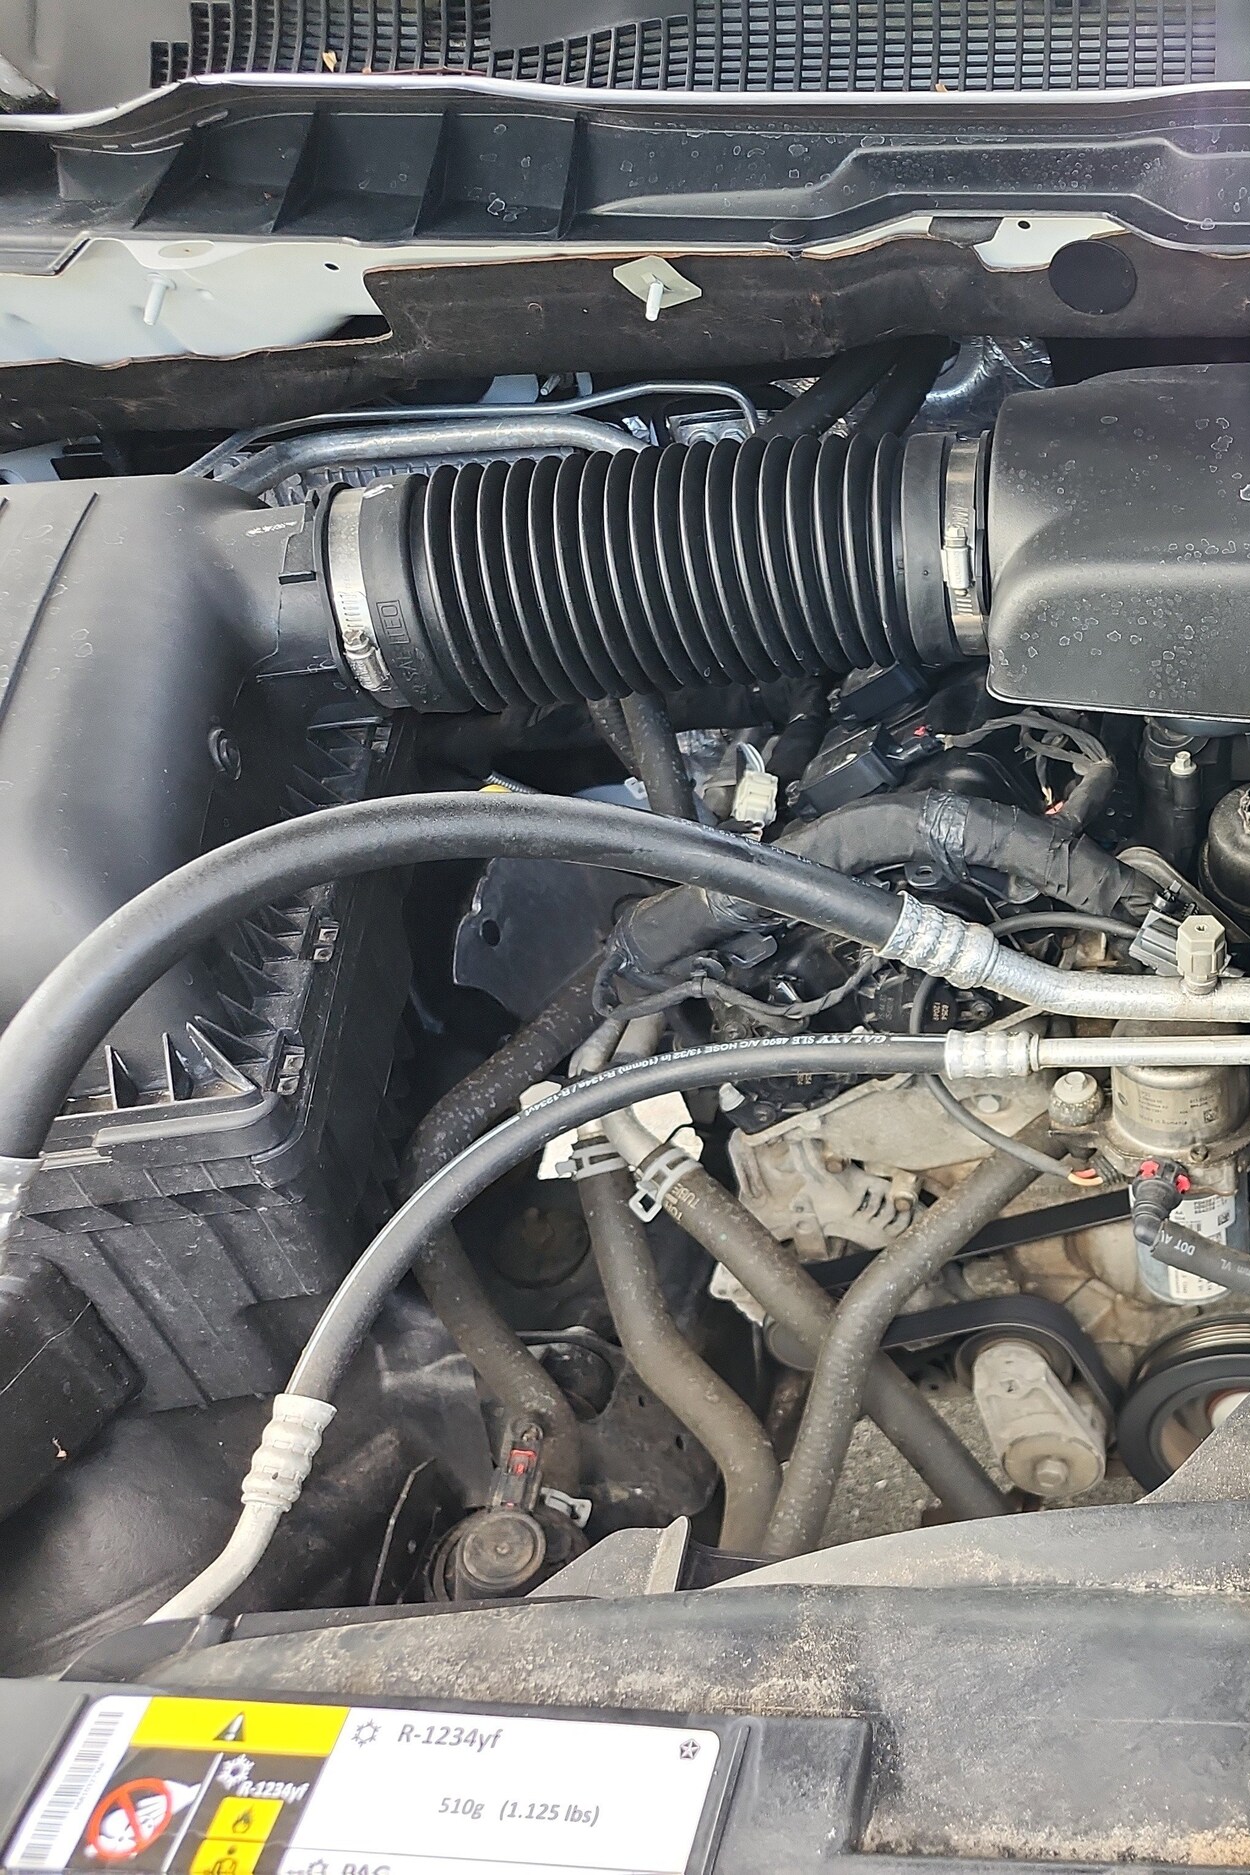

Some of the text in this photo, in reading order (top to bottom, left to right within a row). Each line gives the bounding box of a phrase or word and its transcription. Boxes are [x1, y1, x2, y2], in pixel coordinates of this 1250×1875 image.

[740, 1039, 762, 1049] A/C
[791, 1035, 815, 1045] SLE
[817, 1034, 887, 1045] GALAXY
[704, 1042, 738, 1054] HOSE
[1173, 1239, 1196, 1256] DOT
[397, 1723, 503, 1753] R-1234yf
[235, 1780, 310, 1804] R-1234yf
[438, 1797, 600, 1828] 510g (1.125 lbs)
